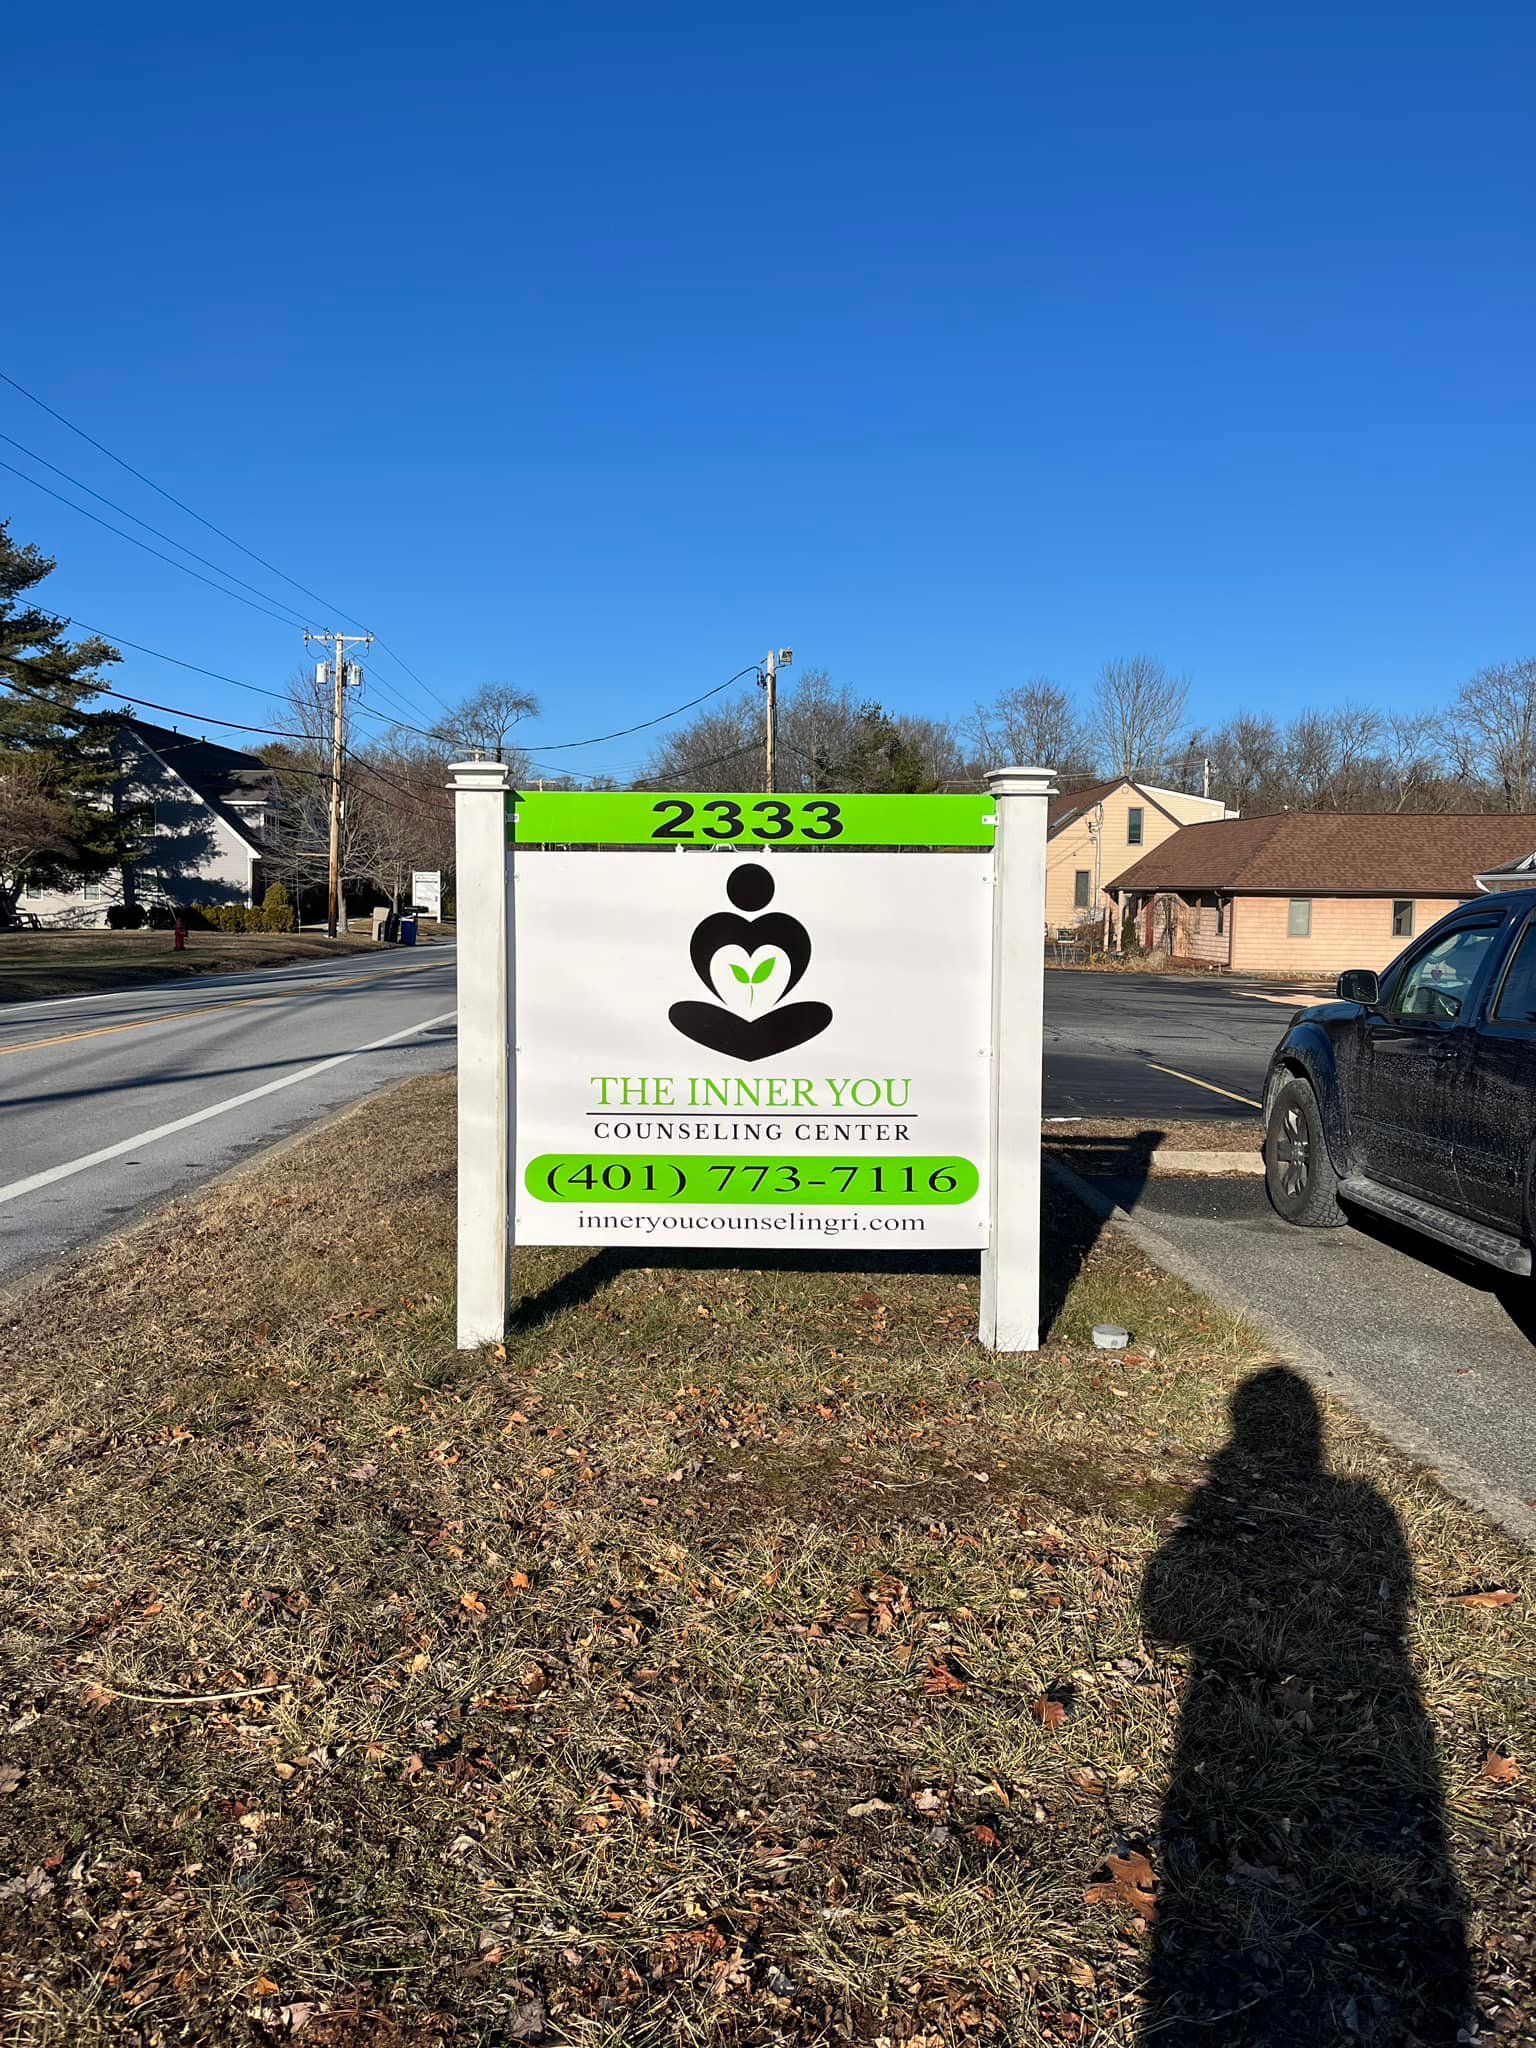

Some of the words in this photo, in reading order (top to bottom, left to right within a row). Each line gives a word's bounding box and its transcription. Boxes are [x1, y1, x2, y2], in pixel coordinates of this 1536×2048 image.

[651, 799, 844, 840] 2333
[592, 1076, 675, 1107] THE
[688, 1077, 818, 1108] INNER
[826, 1078, 911, 1109] YOU
[594, 1122, 782, 1141] COUNSELING
[795, 1124, 910, 1141] CENTER
[547, 1163, 687, 1198] (401)
[708, 1165, 957, 1193] 773-7116
[578, 1210, 925, 1236] inneryoucounselingri.com
